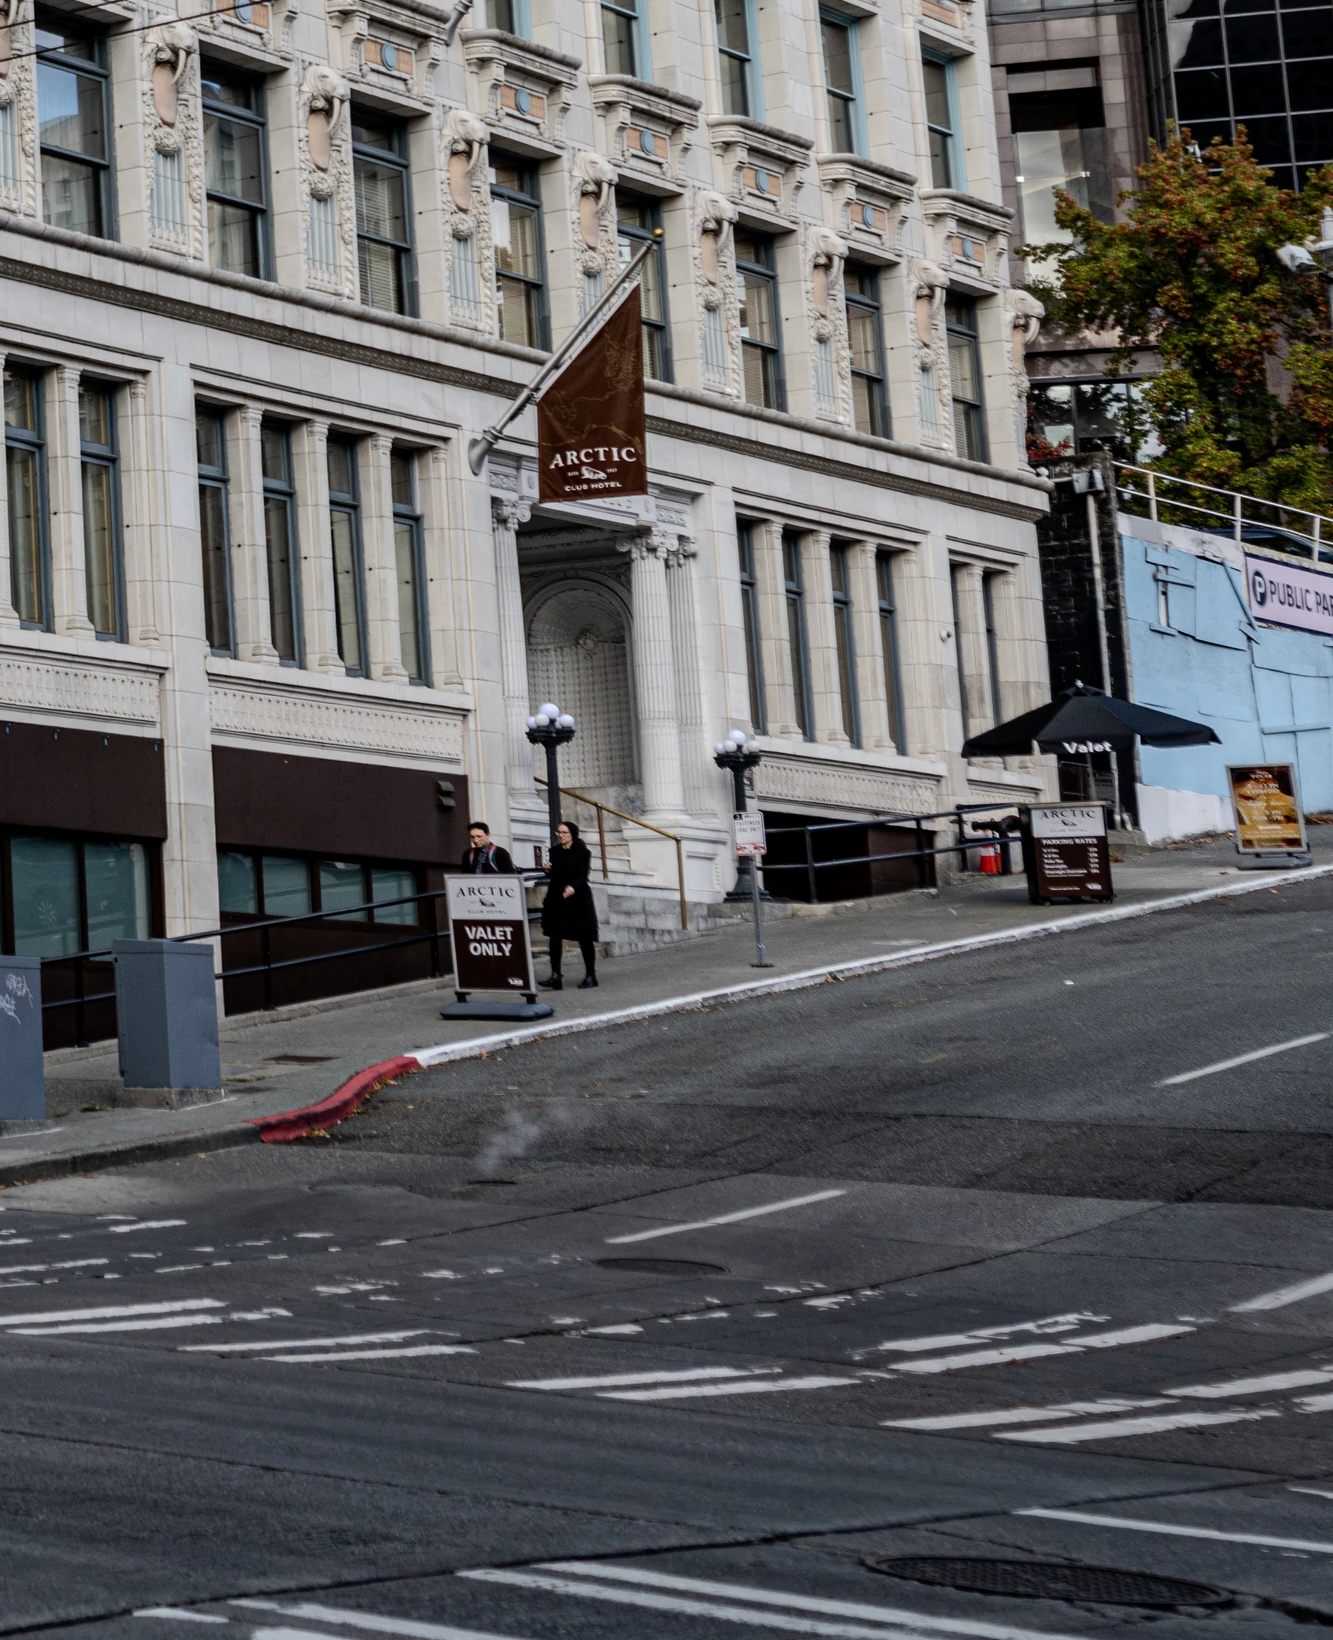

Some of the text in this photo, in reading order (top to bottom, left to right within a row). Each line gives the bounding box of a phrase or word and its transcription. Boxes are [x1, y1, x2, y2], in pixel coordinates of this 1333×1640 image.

[549, 447, 637, 469] ARCTIC
[564, 481, 622, 491] CLUB HOTEL
[1269, 580, 1313, 613] PUBLIC
[1061, 740, 1113, 754] Valet
[1040, 809, 1097, 820] ARCTIC
[1042, 837, 1098, 846] PARKING RATES
[456, 886, 515, 898] ARCTIC
[464, 925, 513, 940] VALET
[468, 942, 513, 957] ONLY
